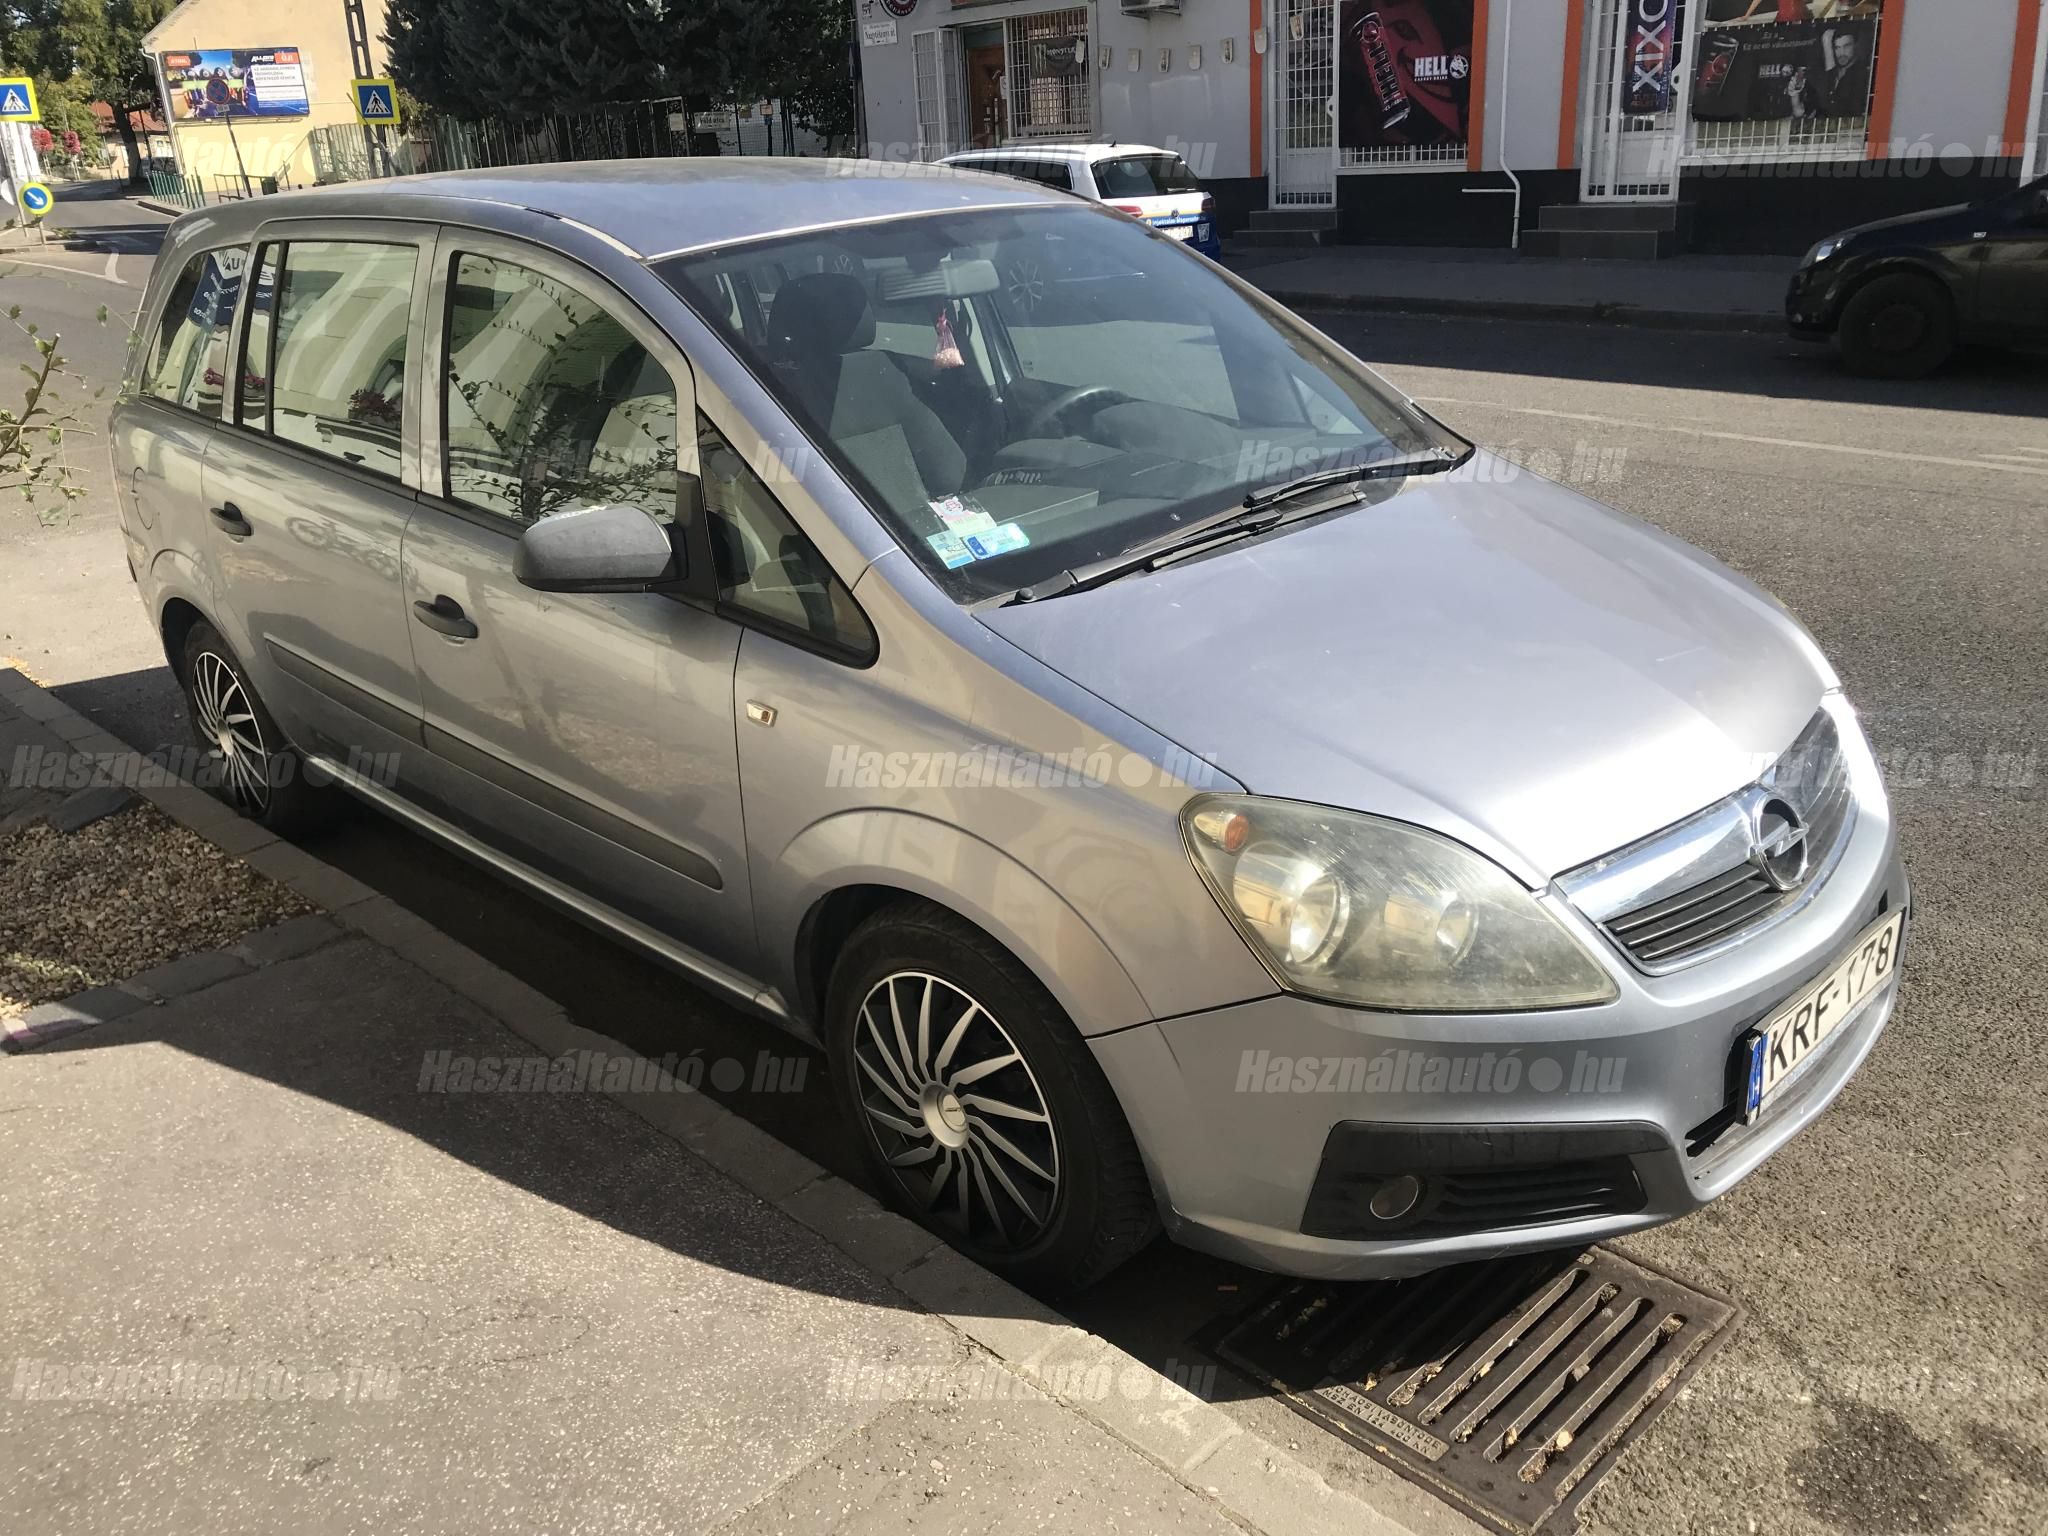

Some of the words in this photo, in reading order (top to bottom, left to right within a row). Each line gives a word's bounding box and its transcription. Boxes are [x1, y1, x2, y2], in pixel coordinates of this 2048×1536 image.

[1414, 55, 1448, 77] HELL
[1759, 64, 1781, 75] HELL
[1769, 925, 1893, 1082] KRF-178
[1323, 1388, 1344, 1405] MSZ
[1347, 1402, 1363, 1415] EN
